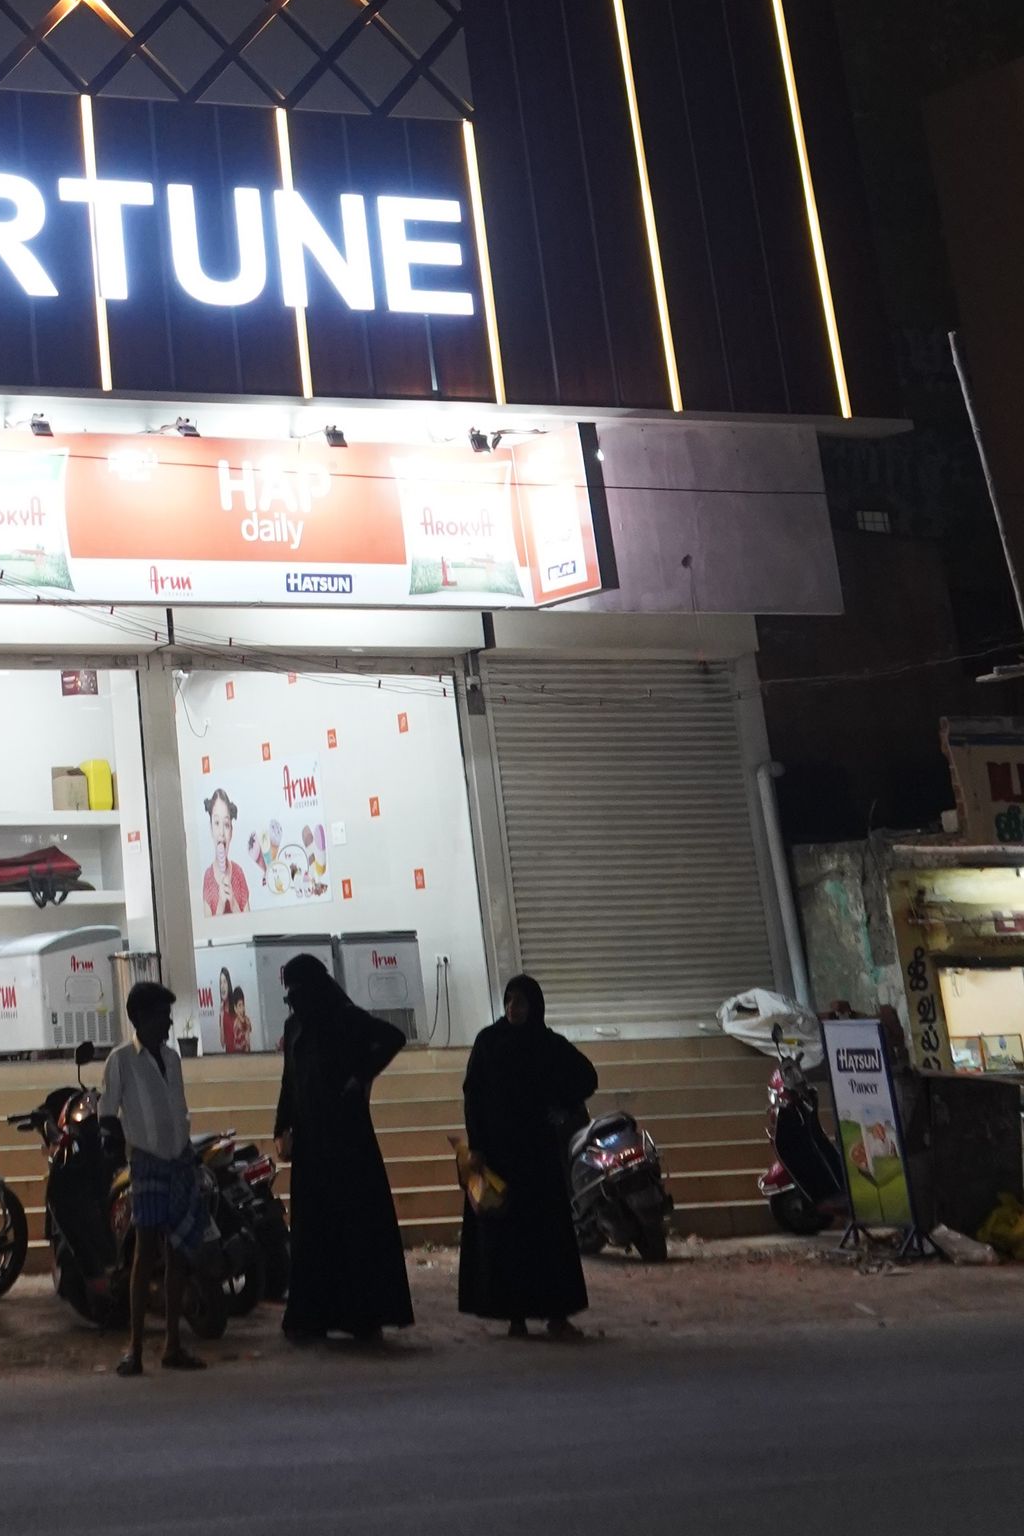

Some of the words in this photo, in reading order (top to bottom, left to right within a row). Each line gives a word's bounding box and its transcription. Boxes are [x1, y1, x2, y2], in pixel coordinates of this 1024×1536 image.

[217, 459, 331, 513] HAP
[241, 511, 304, 549] daily
[149, 566, 192, 595] Arun
[286, 573, 352, 593] HATSUN
[283, 765, 317, 808] Arun
[837, 1047, 881, 1073] HATSUN
